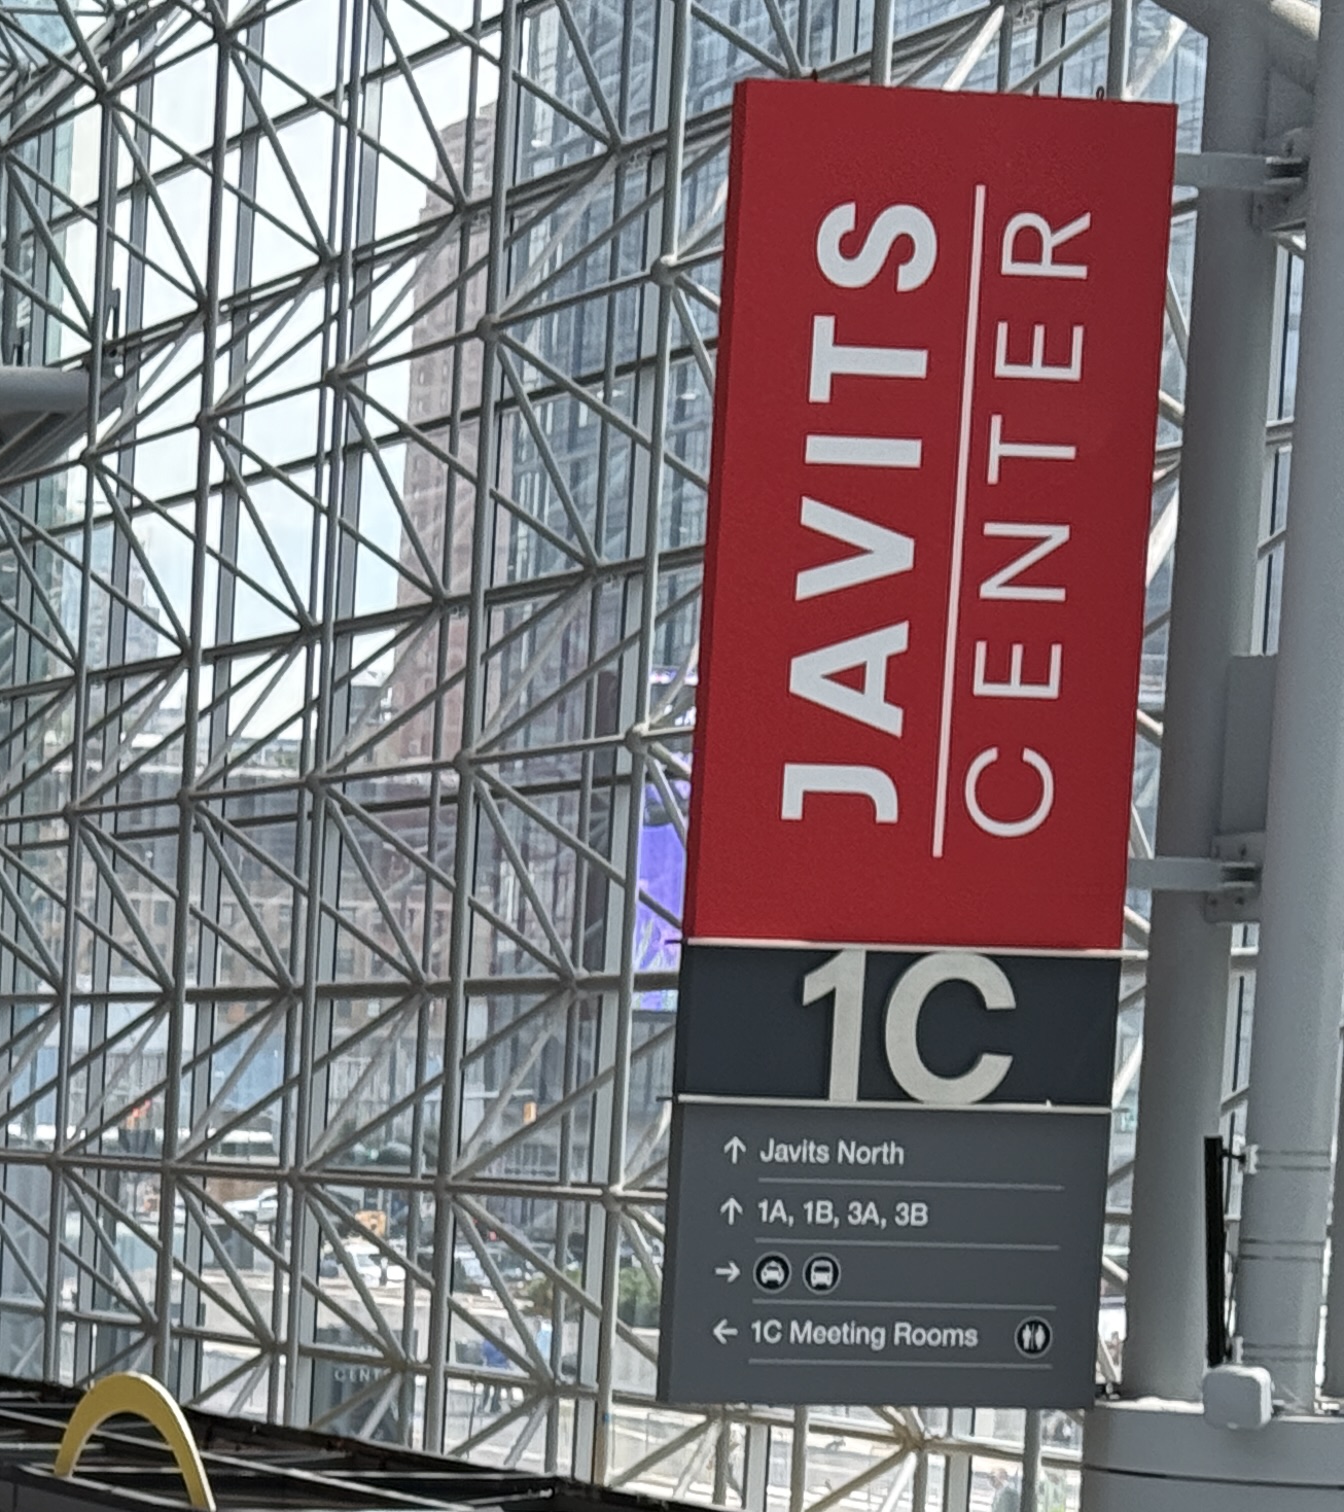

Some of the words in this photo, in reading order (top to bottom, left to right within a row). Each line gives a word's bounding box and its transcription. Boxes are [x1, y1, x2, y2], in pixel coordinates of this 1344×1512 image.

[781, 201, 939, 825] JAVITS
[964, 210, 1092, 838] CENTER
[802, 948, 1017, 1105] 1C
[759, 1138, 830, 1164] Javits
[837, 1140, 904, 1166] North
[758, 1199, 794, 1227] 1A,
[803, 1200, 840, 1228] 1B,
[847, 1201, 887, 1229] 3A,
[894, 1202, 929, 1227] 3B
[751, 1319, 782, 1344] 1C
[789, 1320, 886, 1351] Meeting
[893, 1322, 978, 1347] Rooms
